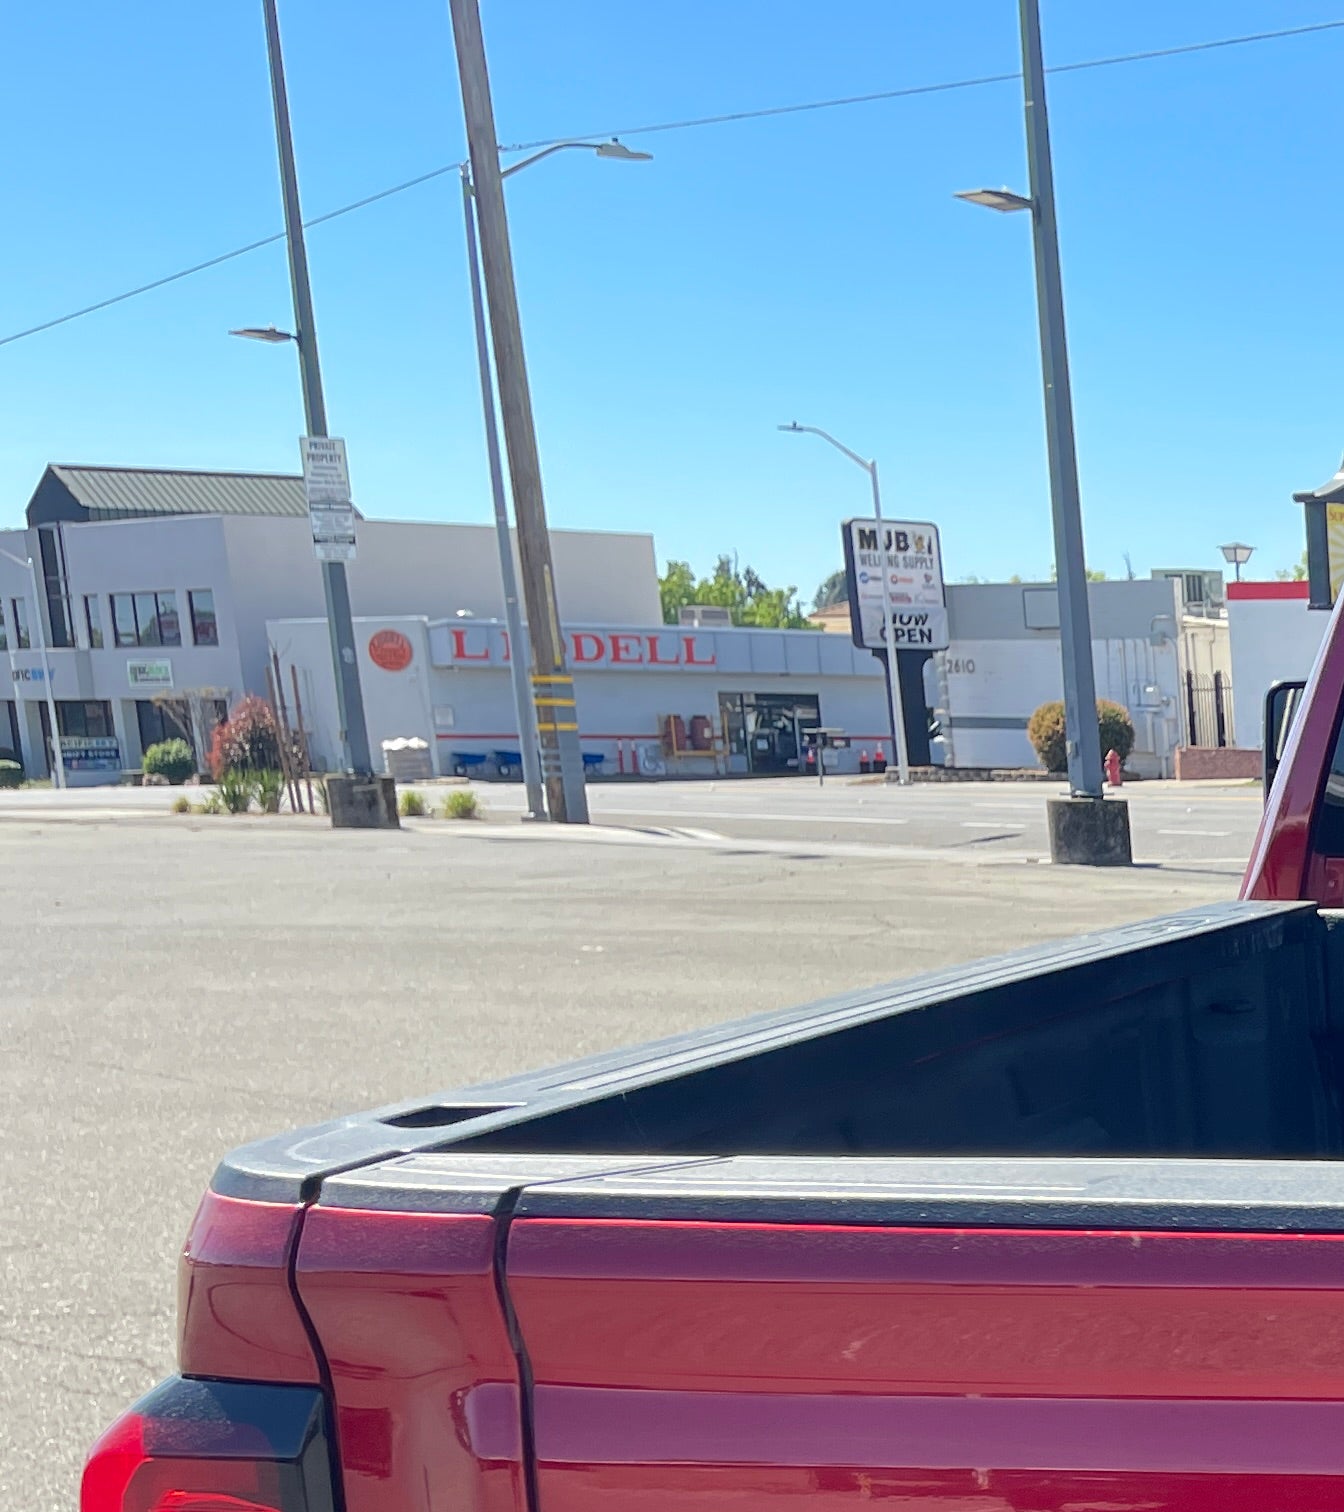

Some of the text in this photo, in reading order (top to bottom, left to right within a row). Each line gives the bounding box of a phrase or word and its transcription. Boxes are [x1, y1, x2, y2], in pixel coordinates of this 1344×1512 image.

[859, 553, 934, 570] WELNG SUPPLY
[451, 629, 717, 666] LDELL
[946, 658, 976, 674] 2610
